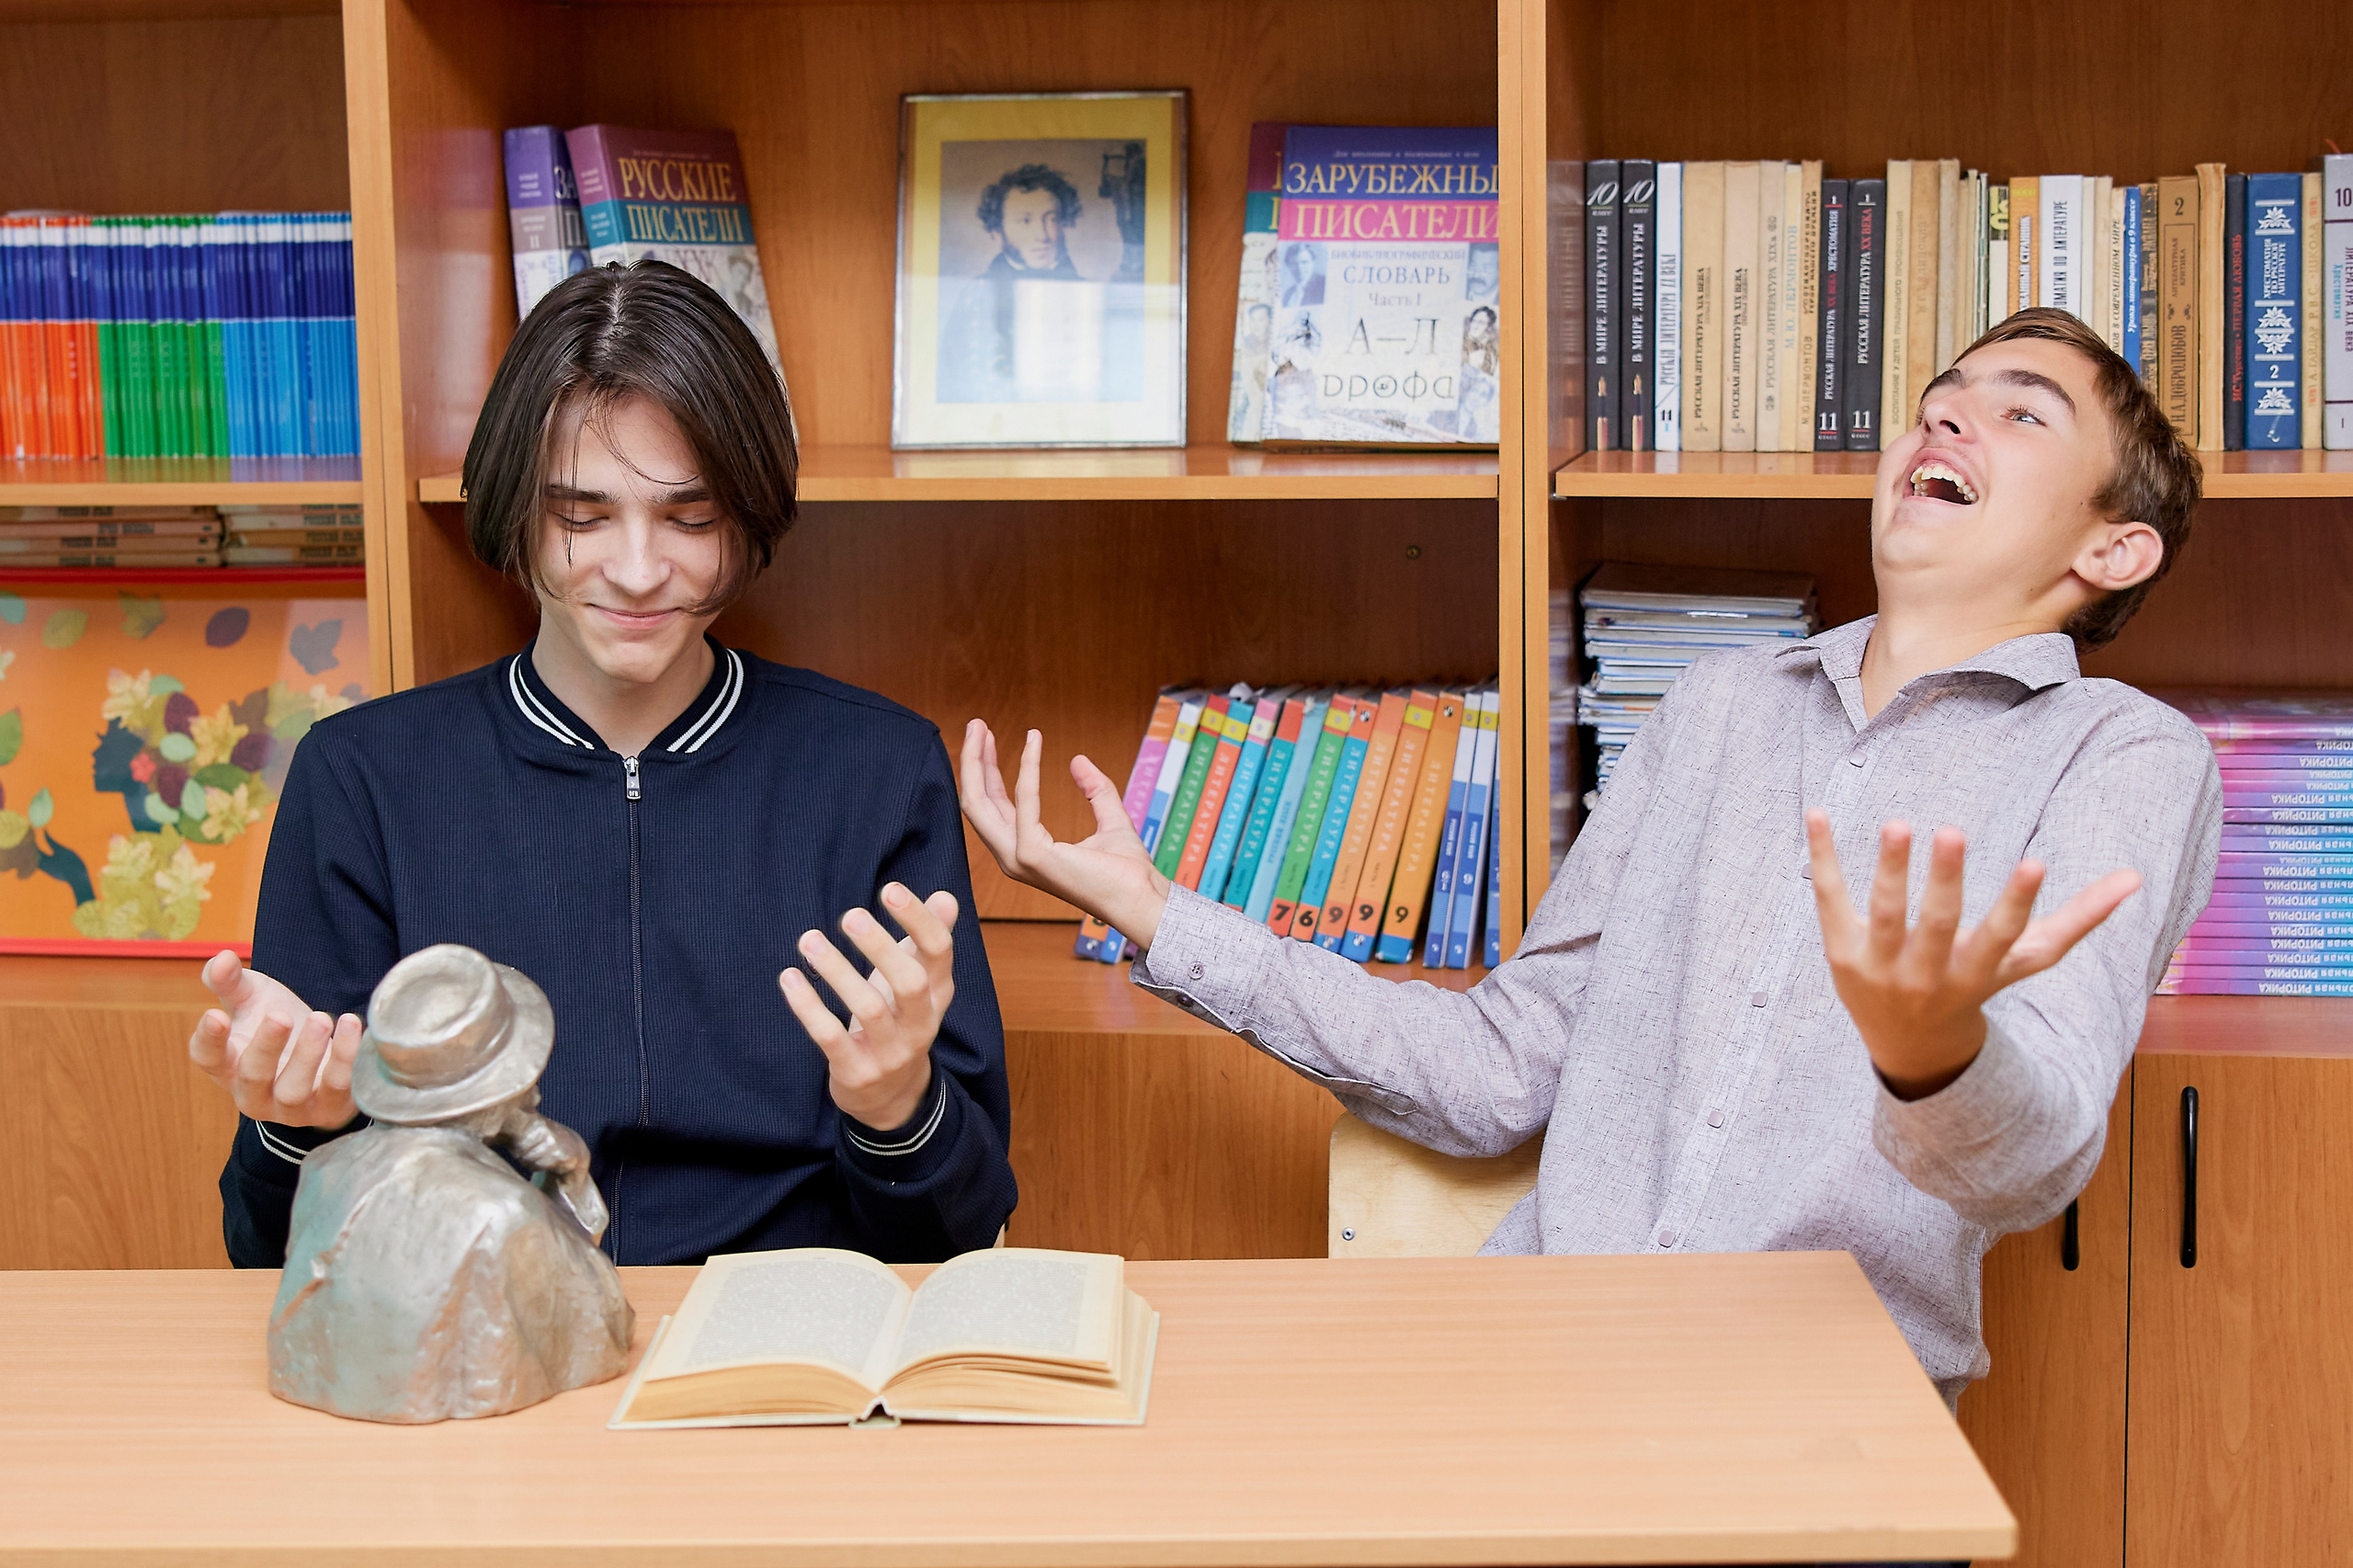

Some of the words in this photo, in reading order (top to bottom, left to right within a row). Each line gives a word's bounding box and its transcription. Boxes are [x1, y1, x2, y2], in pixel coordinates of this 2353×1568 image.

[618, 157, 736, 201] РУССКИЕ
[1586, 181, 1619, 206] 10
[1623, 178, 1654, 203] 10
[2335, 187, 2352, 207] 10
[626, 204, 745, 242] ПИСАТЕЛИ
[1294, 203, 1498, 239] ПИСАТЕЛИ
[1861, 208, 1872, 234] ВЕКА
[2175, 198, 2184, 216] 2
[1827, 210, 1838, 272] ХРЕСТОМАТИЯ
[2053, 200, 2068, 251] ЛИТЕРАТУРЕ
[2112, 219, 2120, 246] МИРЕ
[2232, 233, 2242, 283] ЛЮБОВЬ
[2309, 222, 2320, 273] ШКОЛА
[1343, 266, 1450, 285] СЛОВАРЬ
[1596, 225, 1608, 313] ЛИТЕРАТУРЫ
[1632, 223, 1645, 311] ЛИТЕРАТУРЫ
[1697, 267, 1705, 293] ВЕКА
[1733, 267, 1743, 293] ВЕКА
[1785, 224, 1798, 312] ЛЕРМОНТОВ
[1827, 274, 1836, 295] ВЕКА
[1858, 252, 1871, 317] ЛИТЕРАТУРА
[2112, 248, 2120, 320] СОВРЕМЕННОМ
[2128, 244, 2137, 304] литературы
[2178, 248, 2187, 286] КРИТИКА
[2263, 238, 2271, 299] ХРЕСТОМАТИЯ
[2278, 242, 2286, 296] ЛИТЕРАТУРЕ
[1369, 292, 1413, 306] Часть
[1767, 267, 1778, 335] ЛИТЕРАТУРА
[2271, 280, 2278, 293] ПО
[2333, 264, 2343, 320] Хрестоматия
[1659, 292, 1677, 346] ЛИТЕРАТУРА
[1893, 279, 1903, 335] ПРАВИЛЬНОГО
[2127, 305, 2136, 333] Уроки
[2232, 286, 2242, 331] ПЕРВАЯ
[1596, 316, 1608, 354] МИРЕ
[1631, 313, 1643, 351] МИРЕ
[1695, 312, 1704, 373] ЛИТЕРАТУРА
[1732, 312, 1742, 374] ЛИТЕРАТУРА
[1824, 309, 1836, 362] ЛИТЕРАТУРА
[1857, 318, 1870, 364] РУССКАЯ
[1596, 354, 1608, 365] В
[1631, 353, 1643, 363] В
[1659, 349, 1676, 385] РУССКАЯ
[1765, 339, 1776, 389] РУССКАЯ
[1802, 335, 1813, 402] ЛЕРМОНТОВ
[2269, 365, 2279, 379] 2
[1694, 375, 1702, 419] РУССКАЯ
[1732, 376, 1741, 419] РУССКАЯ
[1824, 363, 1835, 400] РУССКАЯ
[1892, 374, 1901, 425] ВОСПИТАНИЕ
[1819, 412, 1837, 431] 11
[1852, 410, 1871, 429] 11
[2299, 756, 2352, 767] РИТОРИКА
[2309, 770, 2352, 779] РИТОРИКА
[1167, 744, 1209, 851] ЛИТЕРАТУРА
[1244, 750, 1287, 858] ЛИТЕРАТУРА
[1295, 743, 1336, 853] ЛИТЕРАТУРА
[1321, 746, 1360, 859] ЛИТЕРАТУРА
[1347, 743, 1386, 854] ЛИТЕРАТУРА
[1378, 740, 1415, 852] ЛИТЕРАТУРА
[2270, 794, 2325, 804] РИТОРИКА
[2305, 782, 2348, 790] РИТОРИКА
[1187, 753, 1229, 862] ЛИТЕРАТУРА
[1215, 758, 1255, 860] ЛИТЕРАТУРА
[1406, 759, 1441, 872] ЛИТЕРАТУРА
[2271, 811, 2326, 821] РИТОРИКА
[2265, 824, 2319, 835] РИТОРИКА
[2268, 840, 2323, 850] РИТОРИКА
[2262, 867, 2317, 877] РИТОРИКА
[2279, 857, 2322, 865] РИТОРИКА
[2263, 881, 2318, 891] РИТОРИКА
[2264, 895, 2319, 906] РИТОРИКА
[1273, 904, 1290, 921] 7
[1299, 911, 1313, 927] 6
[1328, 906, 1343, 924] 9
[1359, 903, 1374, 921] 9
[1395, 906, 1409, 923] 9
[2268, 911, 2322, 921] РИТОРИКА
[2270, 926, 2325, 937] РИТОРИКА
[2270, 938, 2325, 949] РИТОРИКА
[2264, 968, 2318, 979] РИТОРИКА
[2267, 953, 2321, 964] РИТОРИКА
[2257, 983, 2313, 994] РИТОРИКА
